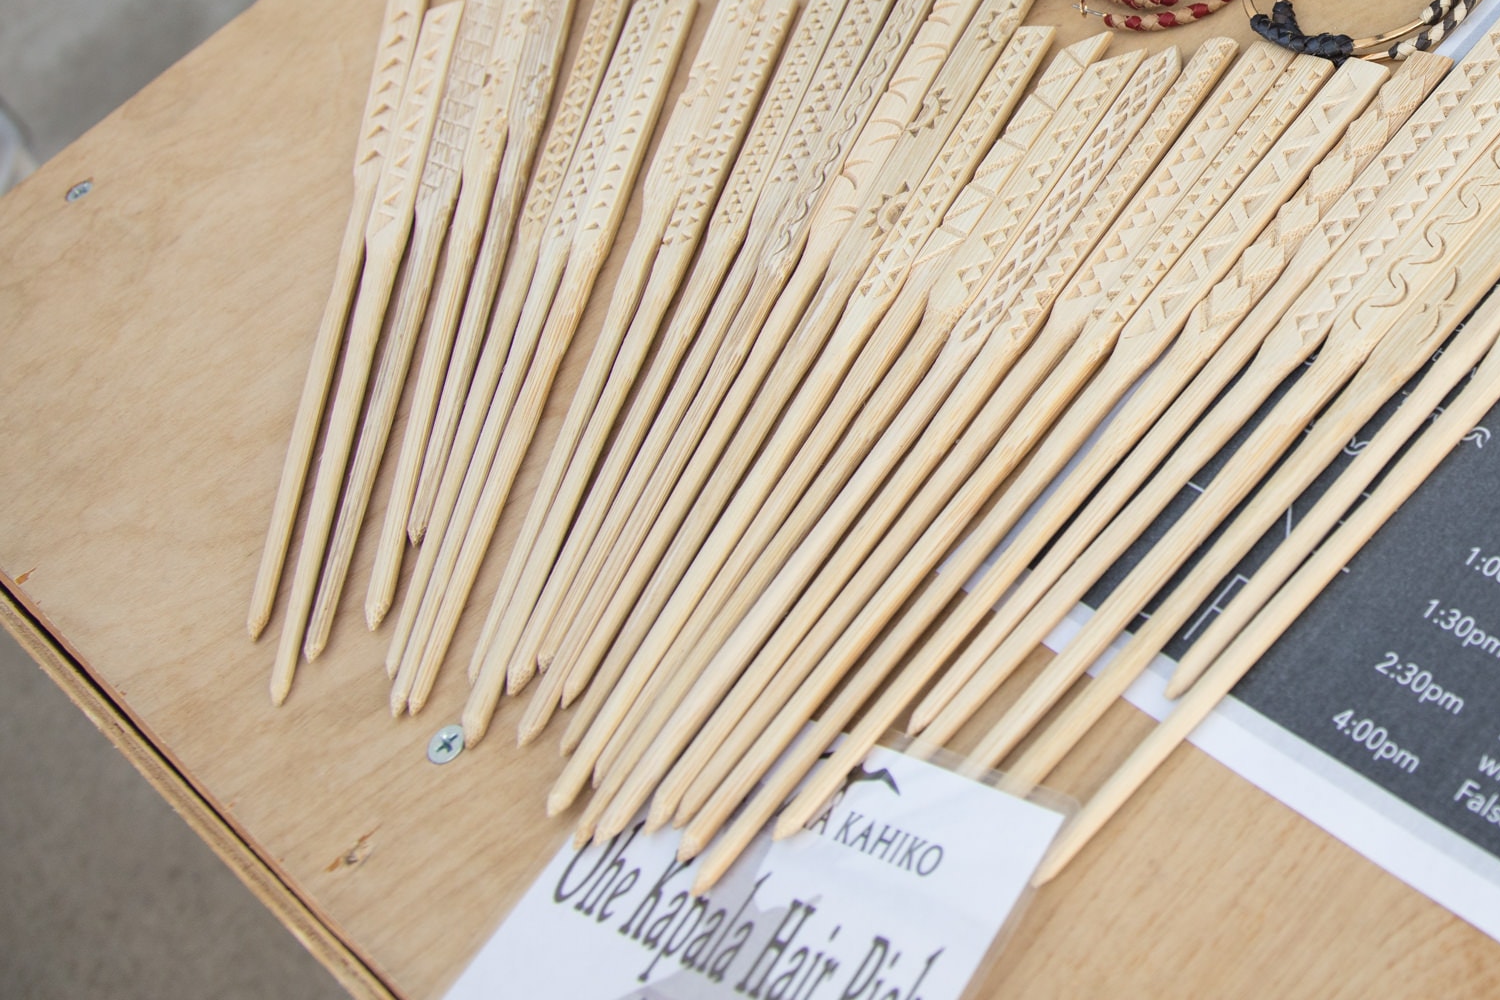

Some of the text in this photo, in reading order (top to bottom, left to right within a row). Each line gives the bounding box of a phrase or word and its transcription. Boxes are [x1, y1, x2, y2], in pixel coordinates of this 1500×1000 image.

[1374, 650, 1466, 716] 2:30pm
[1332, 708, 1421, 775] 4:00pm
[833, 811, 945, 877] KAHIKO
[733, 898, 842, 1000] Hair
